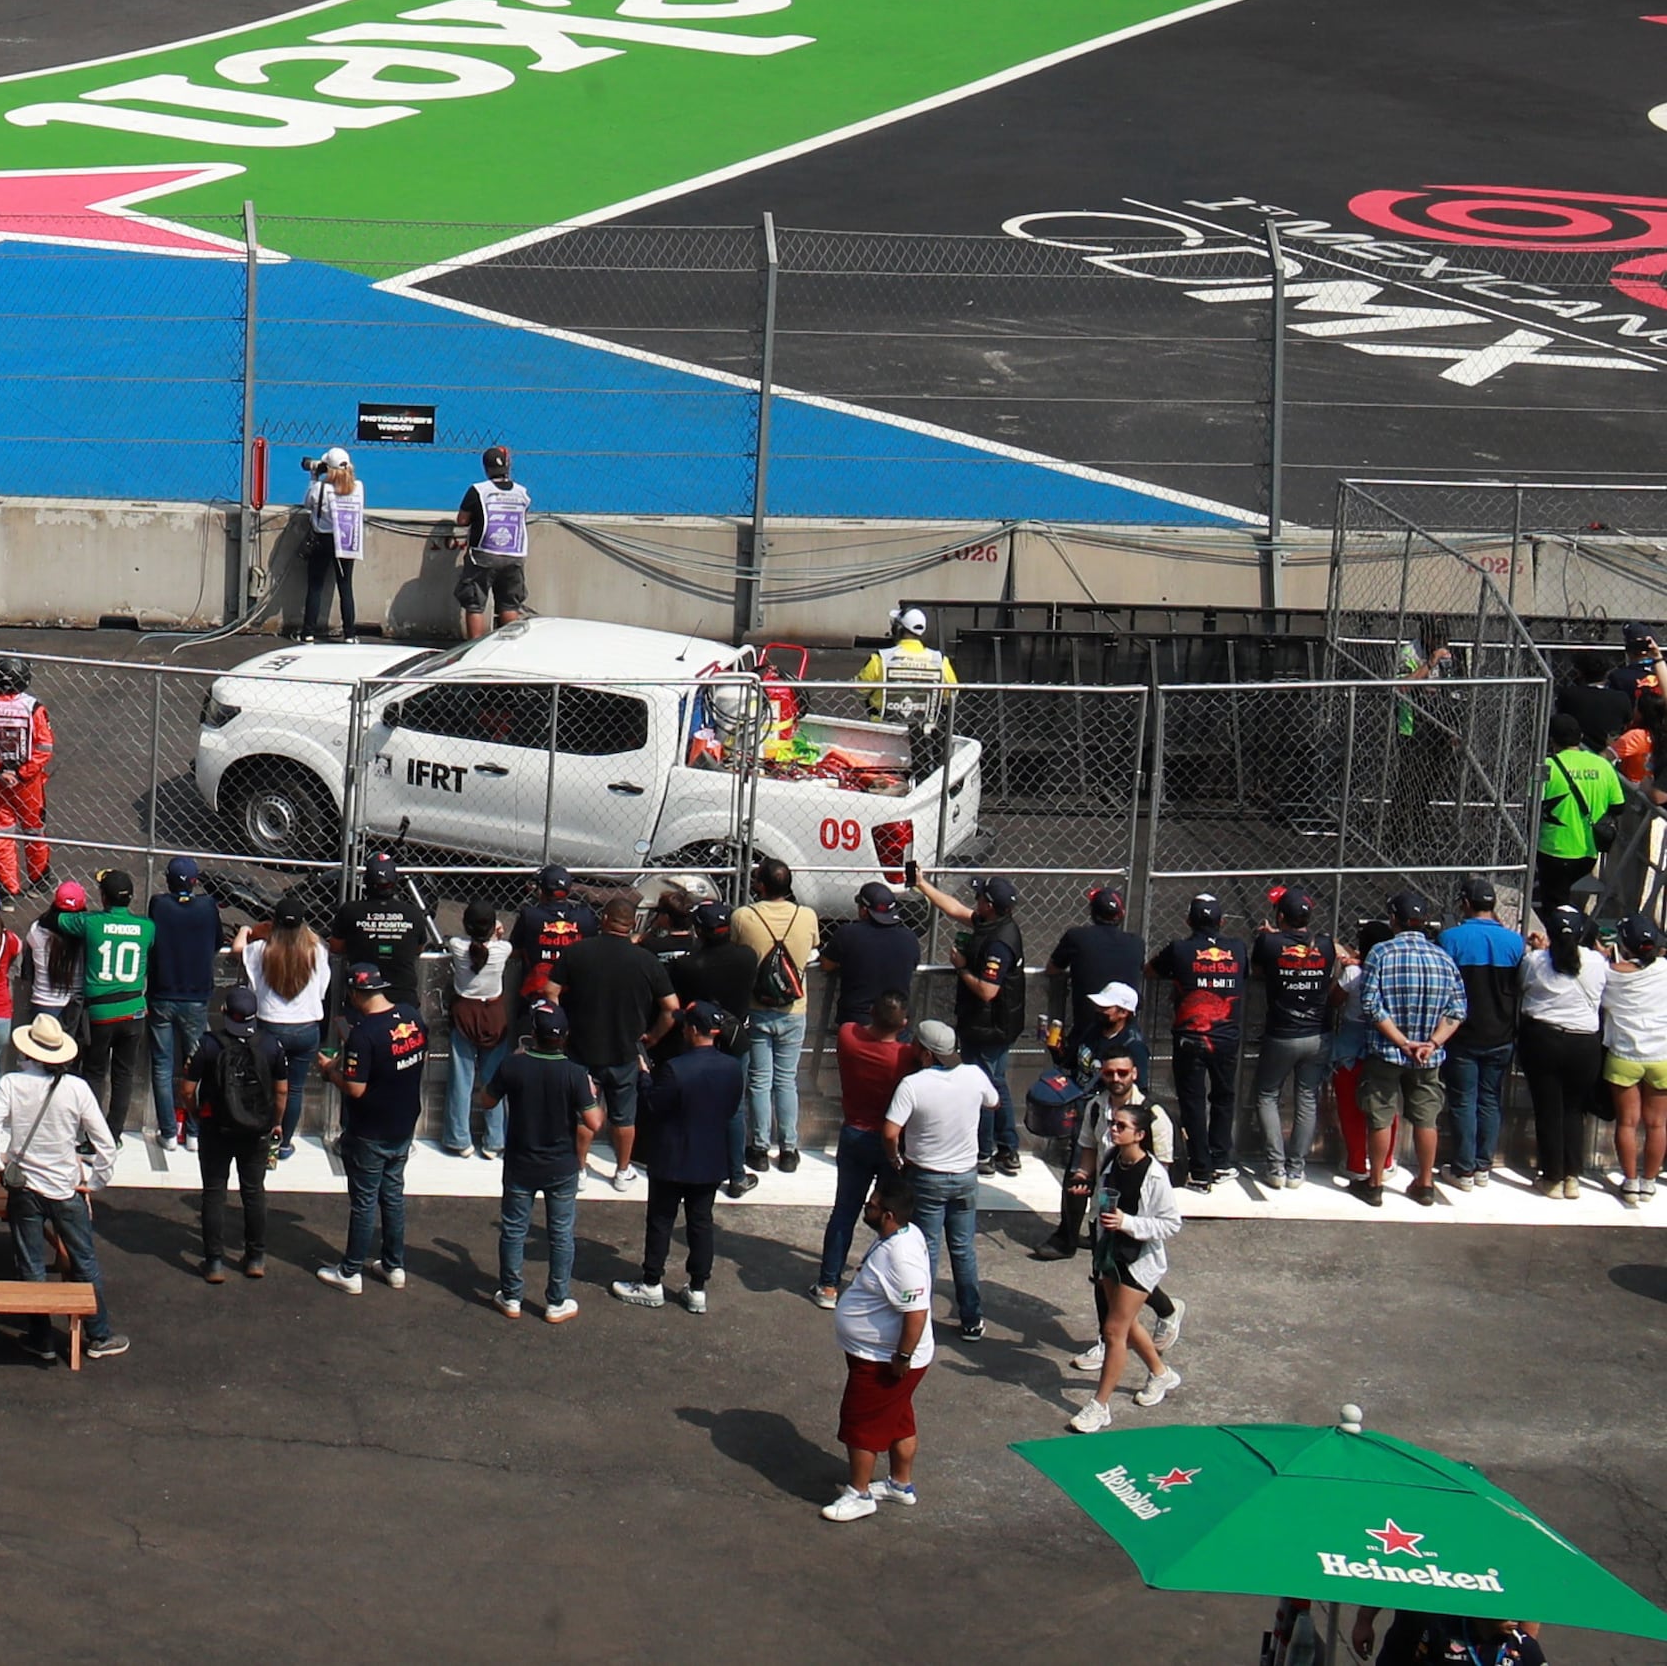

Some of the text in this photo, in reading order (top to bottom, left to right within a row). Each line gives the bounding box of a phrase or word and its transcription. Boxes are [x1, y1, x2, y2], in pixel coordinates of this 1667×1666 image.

[1001, 210, 1659, 387] CDMX
[360, 414, 433, 425] PHOTOGRAPHER'S
[377, 423, 415, 432] WINDOW
[406, 757, 468, 794] IFRT
[819, 817, 862, 852] 09
[103, 923, 142, 937] MENDOZA
[356, 920, 414, 930] POLE POSITION
[539, 935, 560, 947] Red
[97, 940, 142, 984] 10
[1192, 961, 1239, 974] Red Bull
[1197, 978, 1225, 988] Mobil
[391, 1033, 426, 1056] Red Bull
[396, 1054, 418, 1071] Mobil
[1095, 1464, 1163, 1521] Heineken
[1316, 1551, 1505, 1593] Heineken
